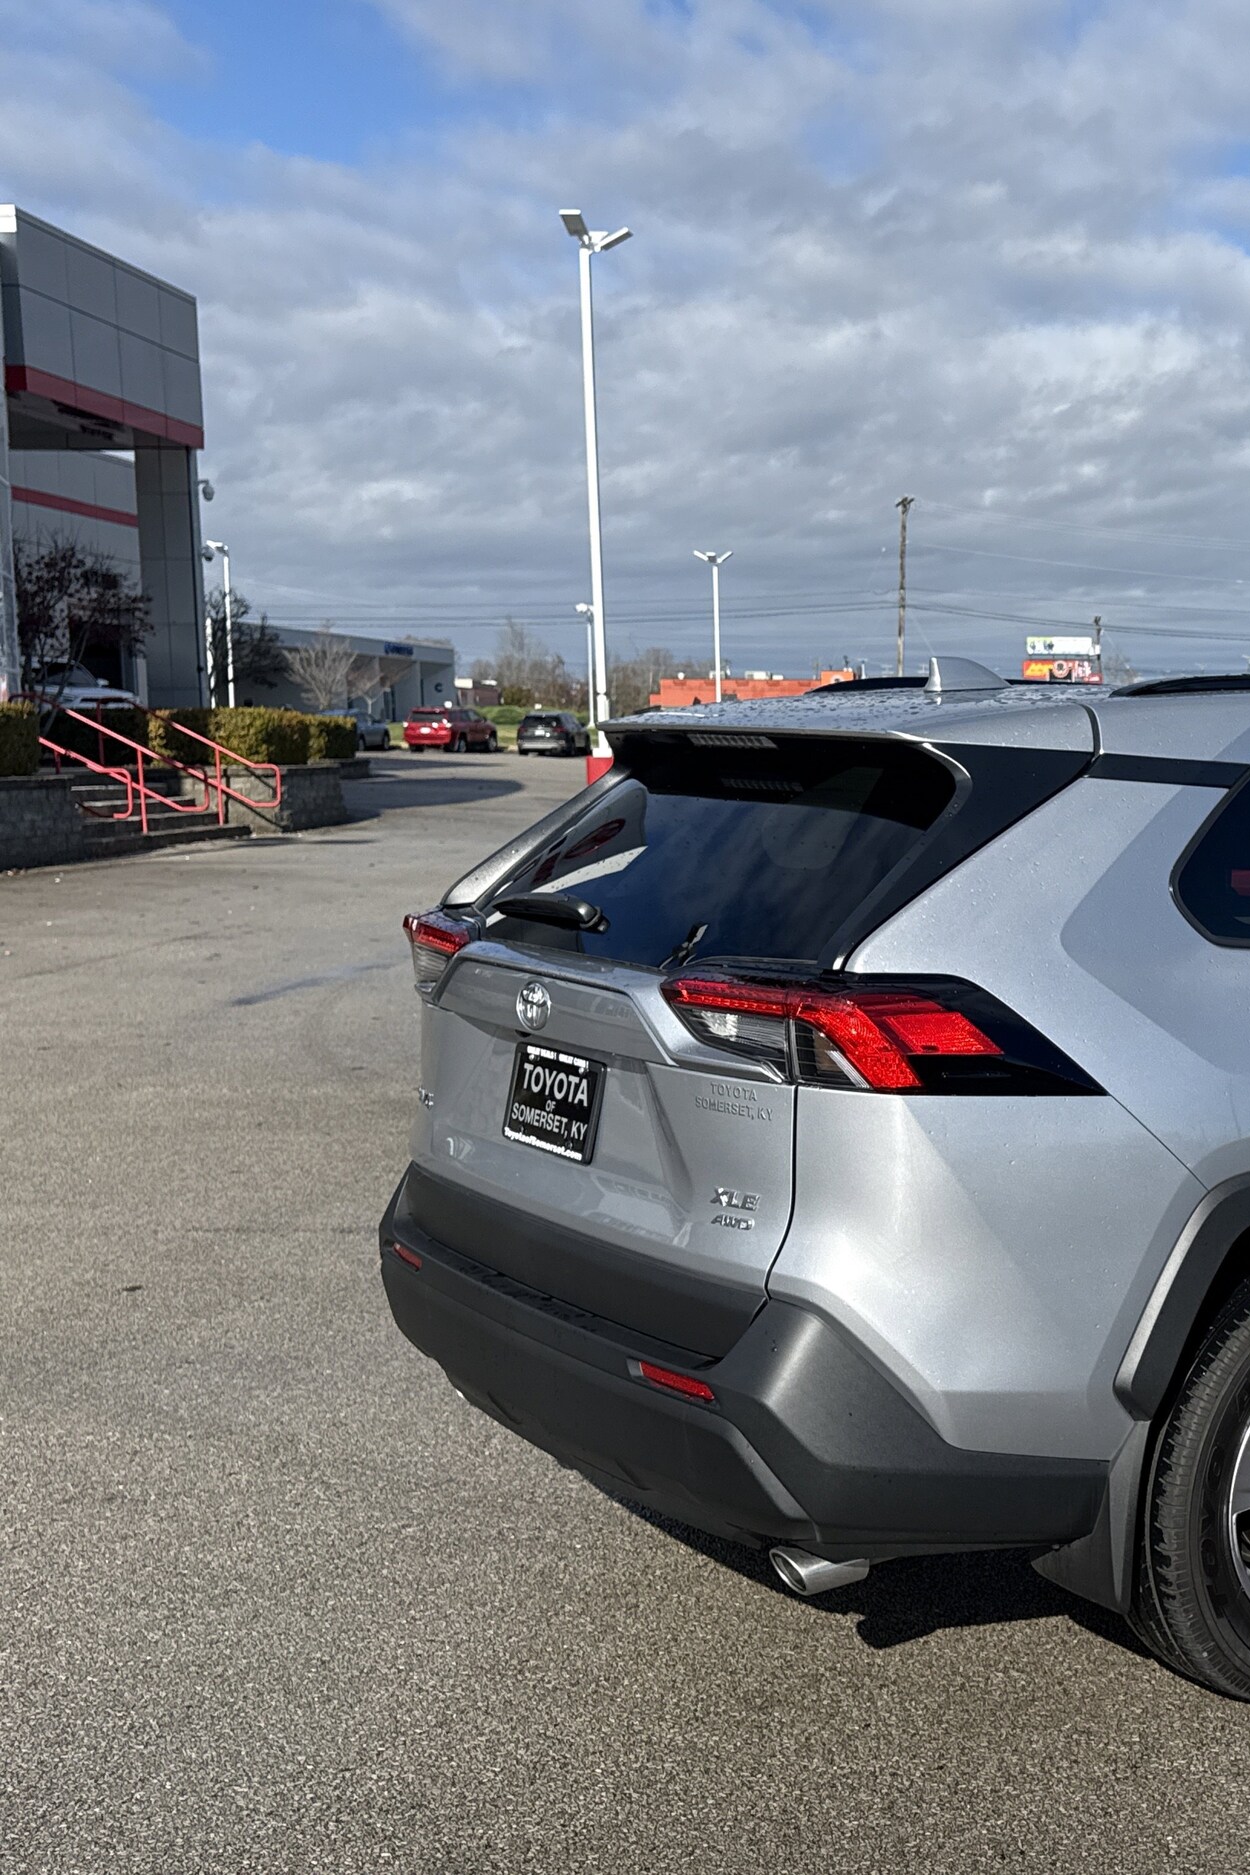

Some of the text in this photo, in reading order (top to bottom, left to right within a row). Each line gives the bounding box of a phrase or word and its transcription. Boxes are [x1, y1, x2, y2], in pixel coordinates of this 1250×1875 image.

[523, 1062, 588, 1107] TOYOTA
[710, 1082, 758, 1101] TOYOTA
[545, 1099, 556, 1111] OF
[695, 1095, 773, 1122] SOMERSET, KY
[511, 1102, 588, 1141] SOMERSET, KY
[710, 1186, 760, 1211] XLE
[711, 1214, 755, 1230] AWD
